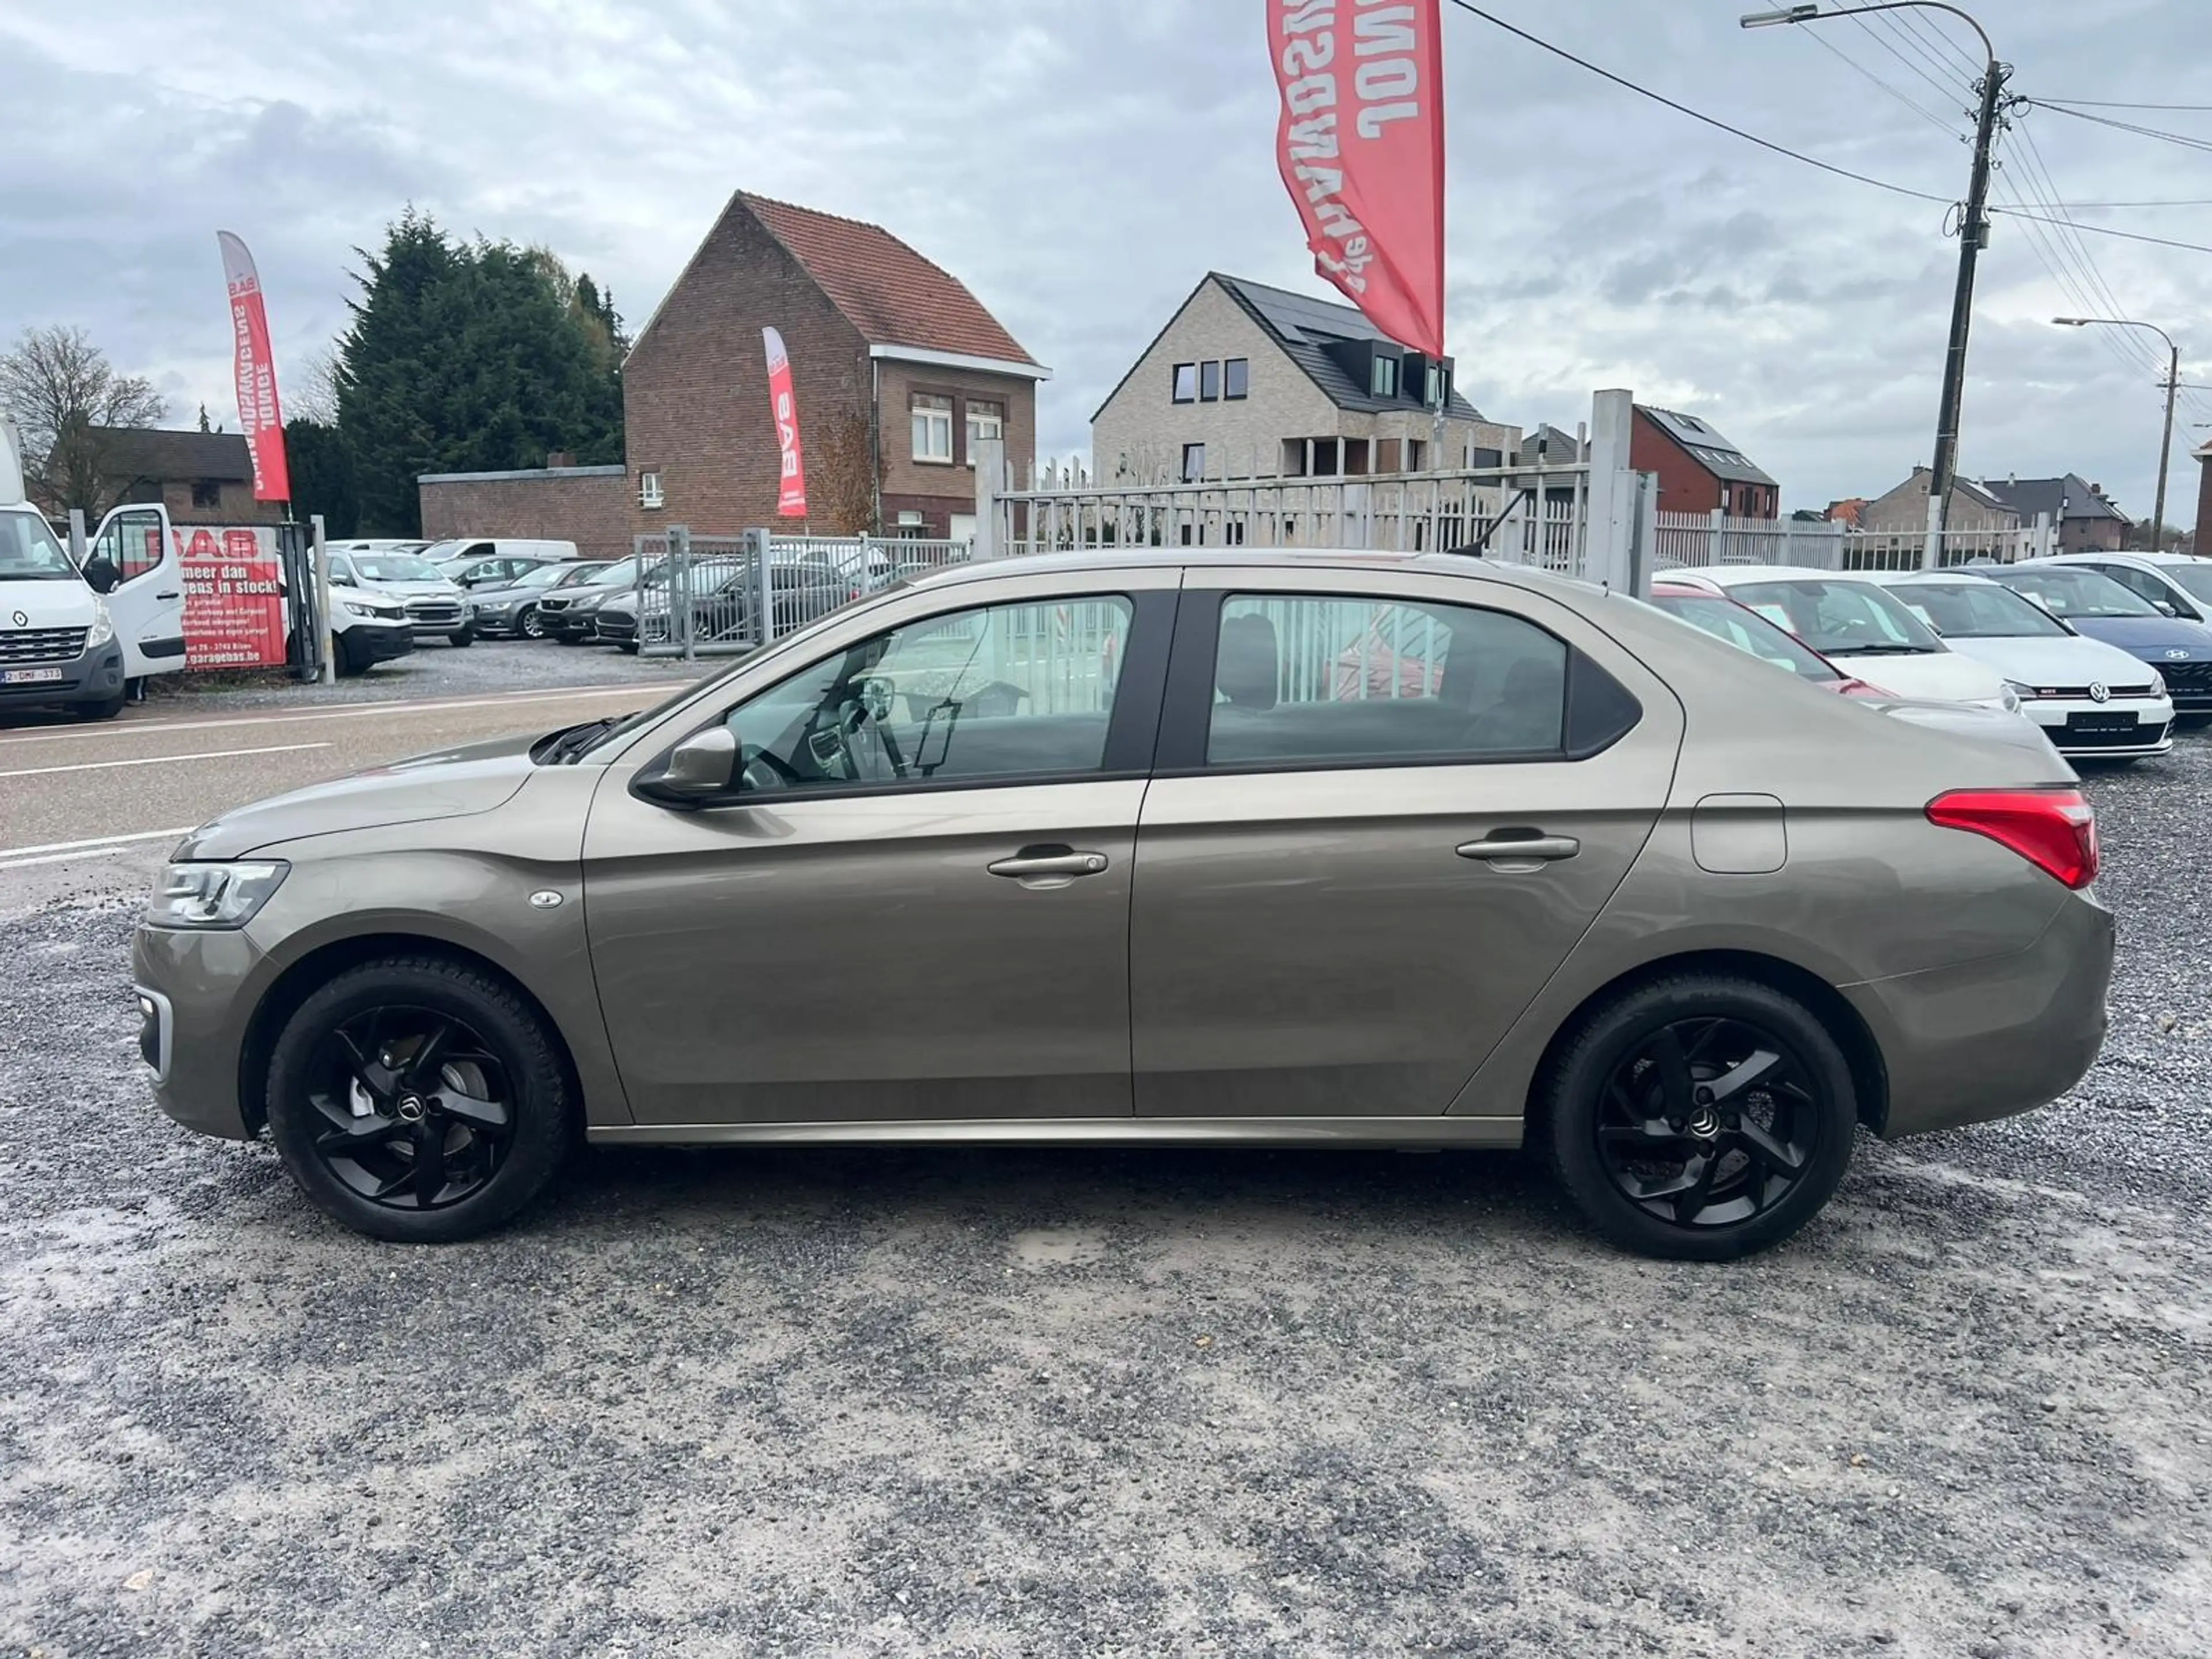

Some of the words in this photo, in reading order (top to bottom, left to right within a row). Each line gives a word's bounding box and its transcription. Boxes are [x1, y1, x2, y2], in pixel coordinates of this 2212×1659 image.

[221, 565, 247, 579] dan
[218, 580, 230, 594] in
[235, 579, 278, 594] stock!
